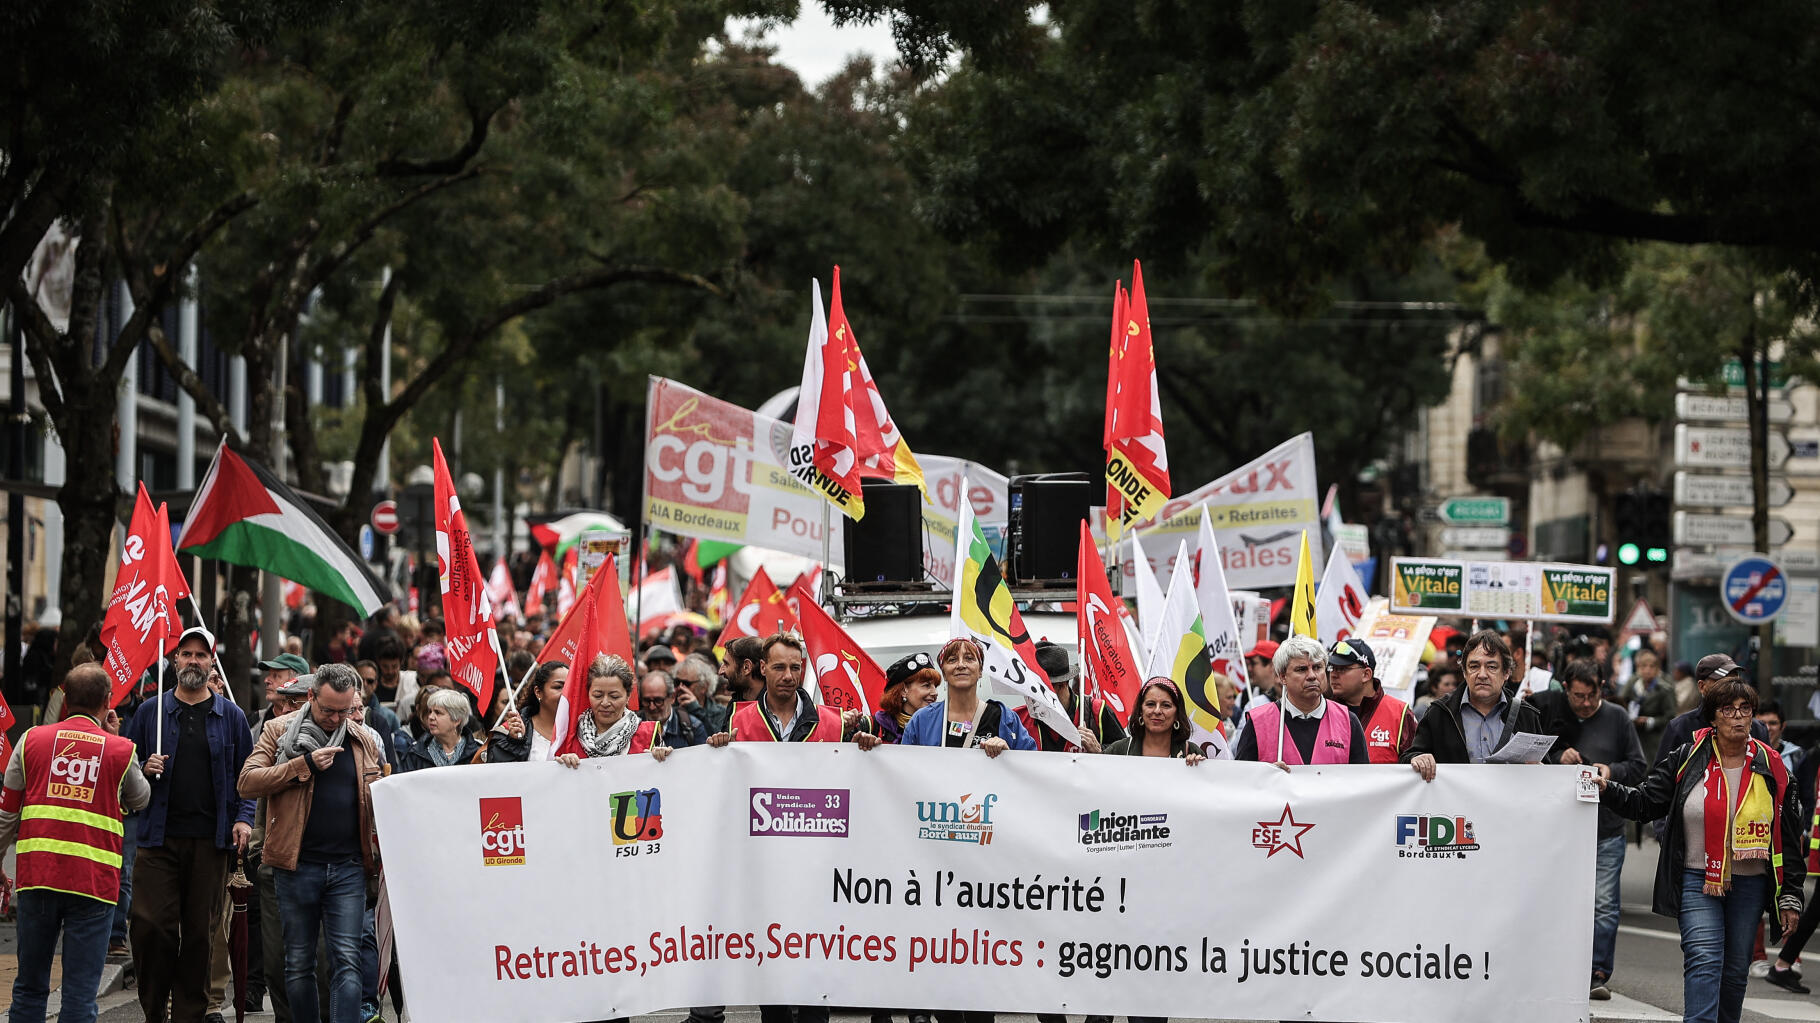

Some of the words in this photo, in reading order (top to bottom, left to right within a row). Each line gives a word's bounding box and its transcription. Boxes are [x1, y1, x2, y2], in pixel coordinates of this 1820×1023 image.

[646, 434, 754, 503] cgt
[650, 502, 671, 519] AIA
[674, 509, 741, 532] Bordeaux
[771, 507, 836, 541] Pour
[1229, 506, 1298, 524] Retraites
[1405, 575, 1460, 594] Vitale
[1552, 582, 1607, 602] Vitale
[1095, 618, 1127, 678] Fédération
[59, 732, 103, 743] RÉGULATION
[51, 755, 101, 785] cgt
[51, 784, 71, 796] UD
[73, 787, 90, 799] 33
[825, 794, 841, 809] 33
[752, 792, 847, 834] Solidaires
[1080, 809, 1138, 832] Union
[919, 828, 979, 841] Bordeaux
[937, 822, 966, 830] syndicat
[966, 823, 993, 831] étudiant
[1081, 825, 1170, 845] étudiante
[482, 824, 526, 856] cgt
[1252, 829, 1282, 844] FSE
[615, 845, 639, 858] FSU
[646, 843, 661, 855] 33
[1398, 849, 1451, 859] Bordeaux
[485, 857, 495, 865] UD
[496, 857, 523, 865] Gironde
[1711, 860, 1721, 869] 33
[833, 867, 892, 905] Non
[904, 870, 922, 906] à
[935, 871, 1105, 913] l'austérité
[1119, 877, 1126, 914] !
[909, 928, 1023, 972] publics
[1058, 941, 1188, 979] gagnons
[1201, 936, 1228, 974] la
[1237, 938, 1349, 984] justice
[1360, 943, 1473, 980] sociale
[1484, 951, 1490, 981] !
